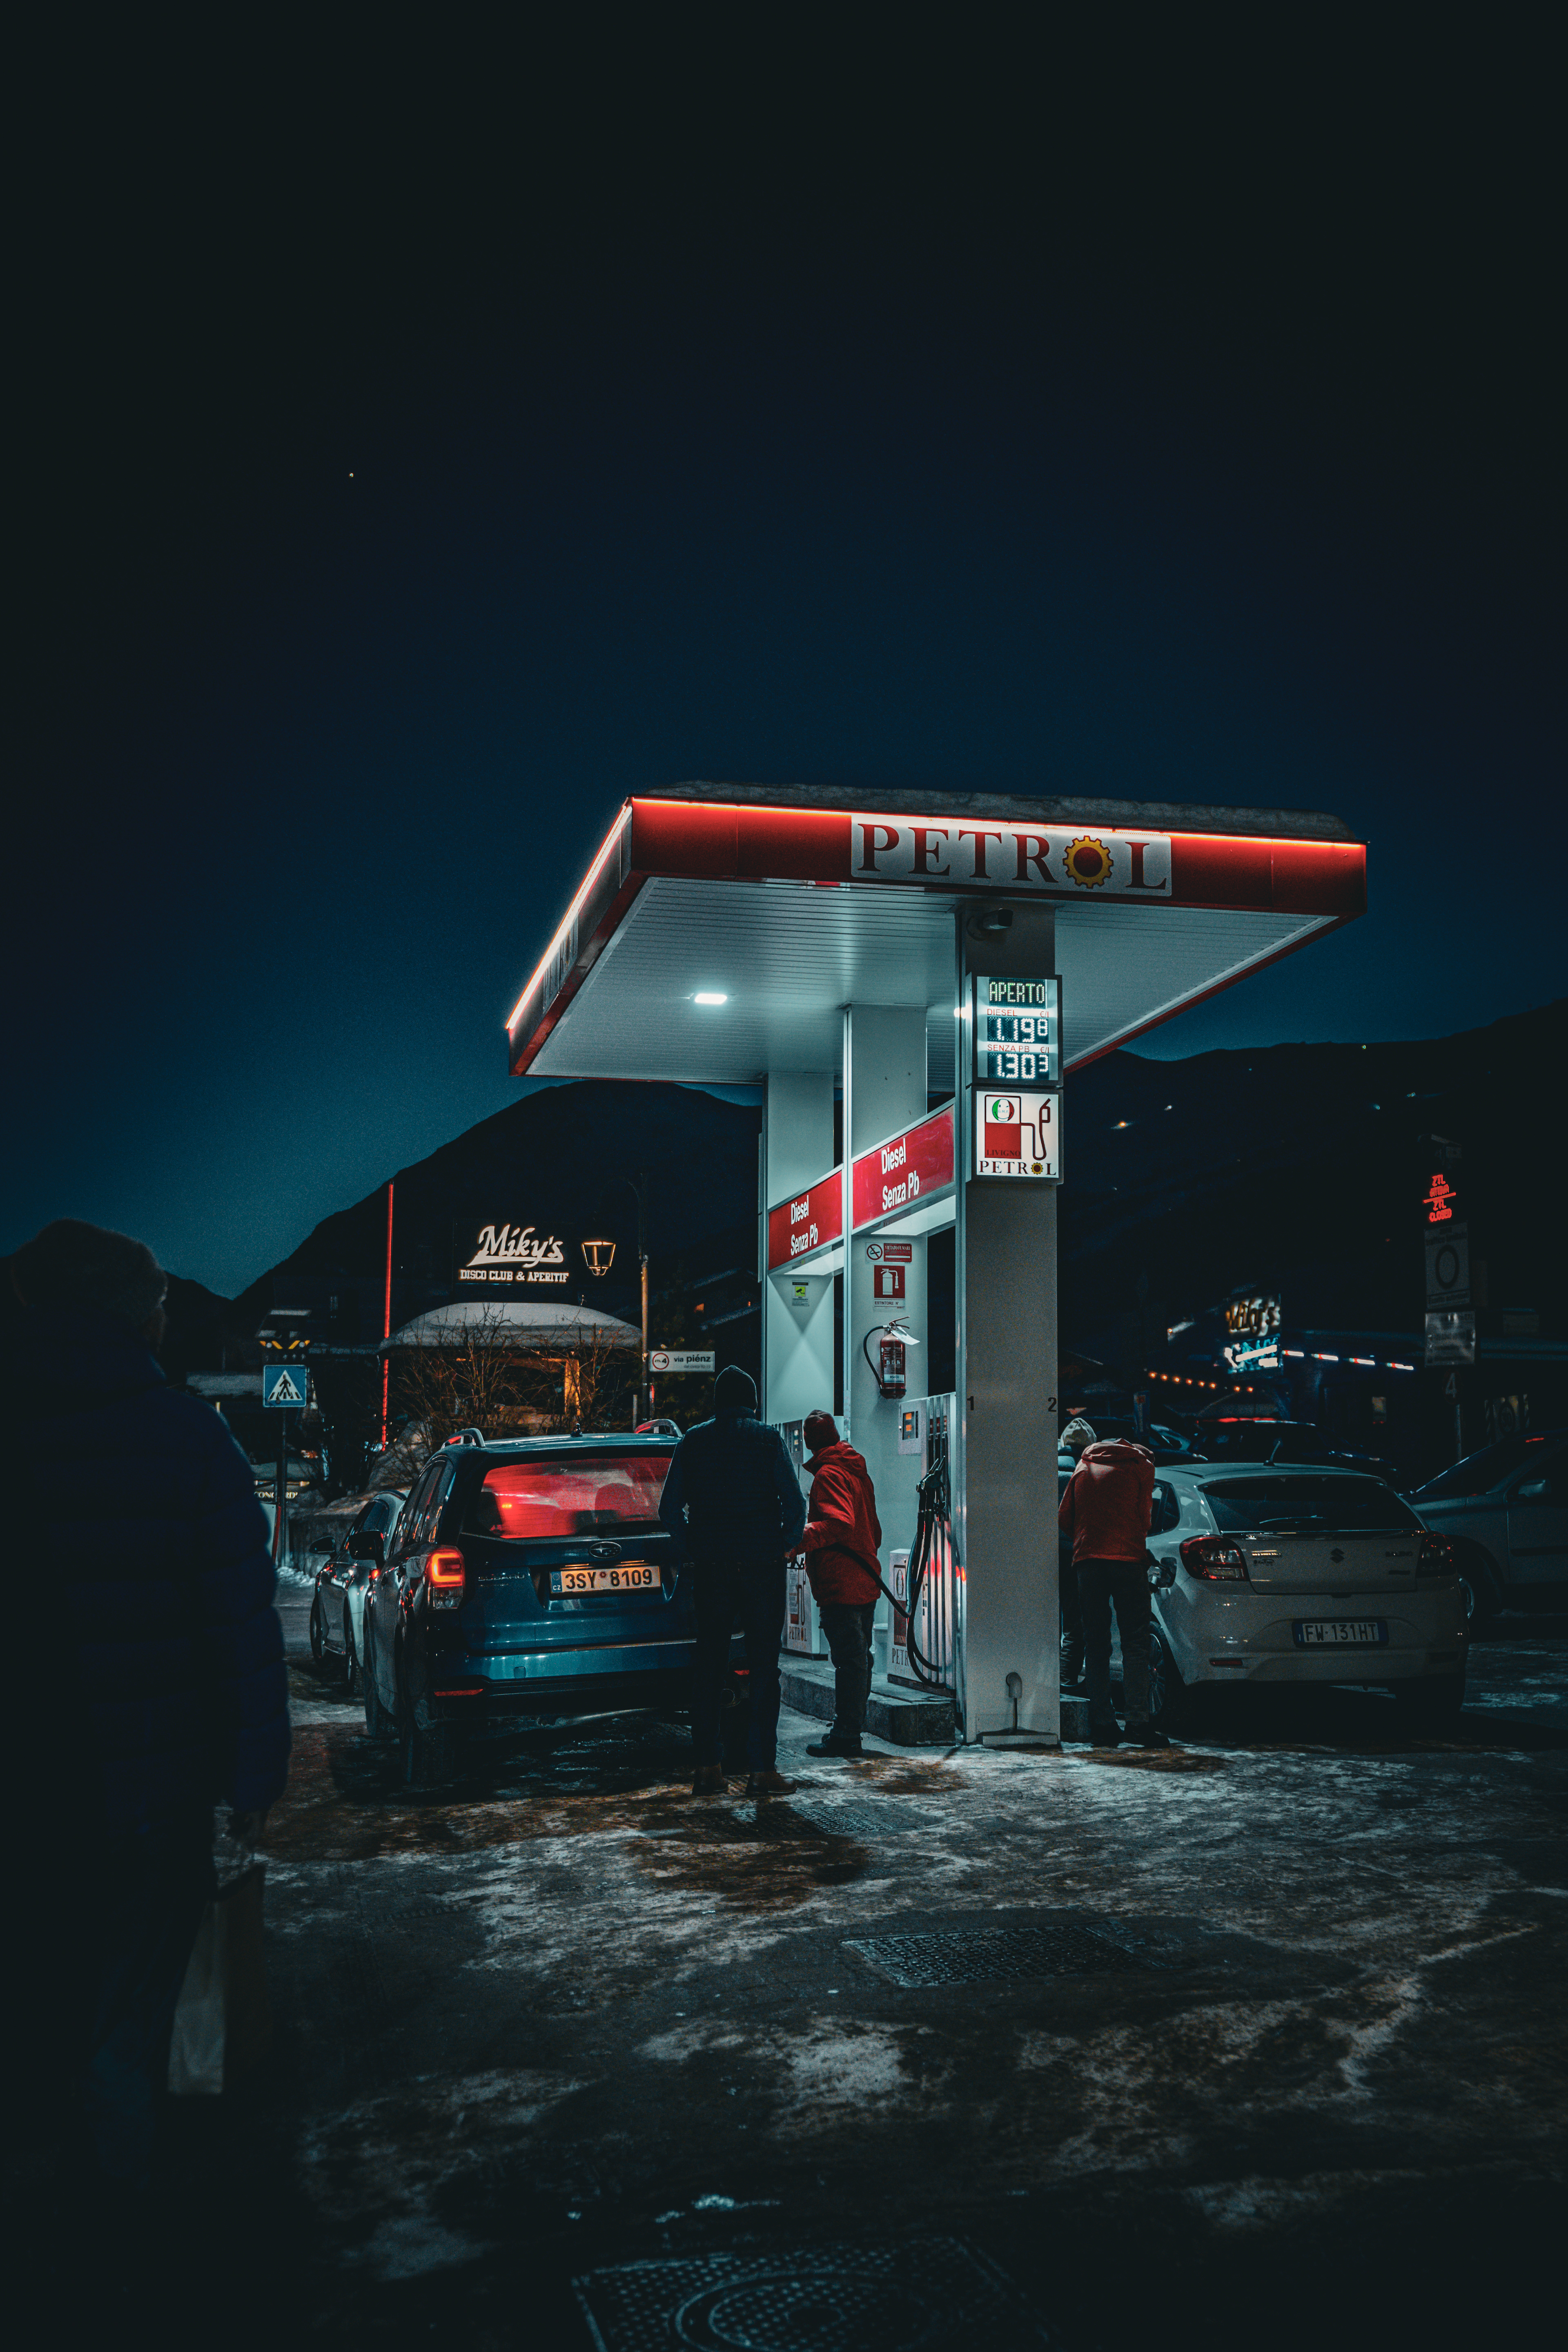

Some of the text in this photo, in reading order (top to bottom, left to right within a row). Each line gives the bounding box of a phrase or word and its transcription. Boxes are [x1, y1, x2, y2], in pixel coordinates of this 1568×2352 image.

[857, 823, 1167, 891] PETROL
[989, 981, 1045, 1003] APERTO
[987, 1009, 1017, 1017] DIESEL
[881, 1138, 906, 1175] Diesel
[979, 1160, 1056, 1175] PETROL
[882, 1170, 920, 1211] Senza Pb
[791, 1194, 809, 1225] Diesel
[466, 1224, 564, 1268] Miky's
[791, 1223, 818, 1256] Senza Pb
[460, 1269, 569, 1283] DISCO CLUB & APERITIF
[686, 1354, 711, 1364] piénz
[967, 1396, 974, 1410] 1
[1048, 1397, 1057, 1412] 2
[565, 1568, 653, 1589] 3SY 8109
[789, 1626, 807, 1642] PETROL
